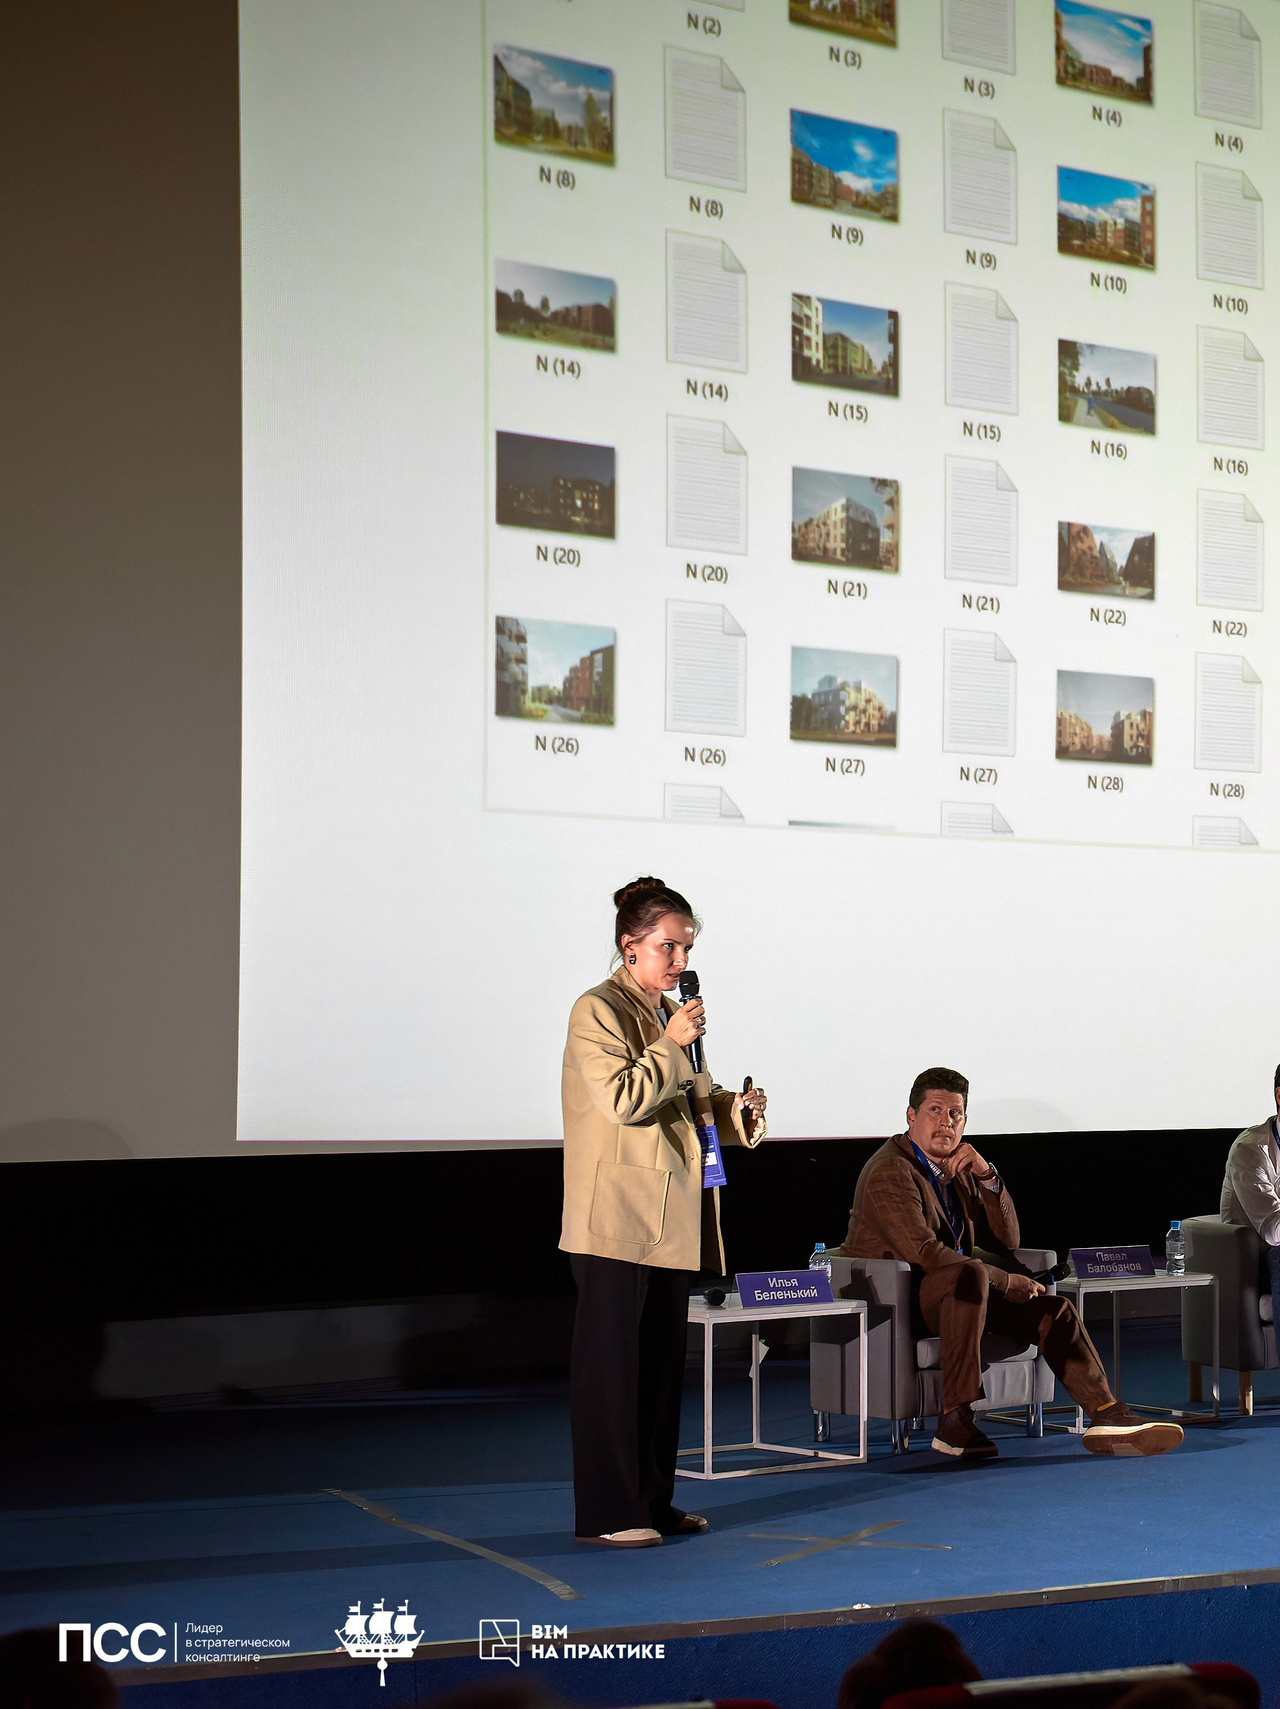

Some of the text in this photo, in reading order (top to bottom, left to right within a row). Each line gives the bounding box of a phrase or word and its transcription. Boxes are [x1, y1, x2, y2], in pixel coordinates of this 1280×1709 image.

[829, 45, 862, 70] N (3)
[539, 165, 576, 191] N (8)
[1091, 440, 1127, 460] N (16)
[536, 545, 581, 567] N (20)
[1096, 1251, 1128, 1262] Павел
[1087, 1262, 1142, 1273] Балобанов
[768, 1277, 799, 1288] Илья
[754, 1286, 818, 1301] Беленький
